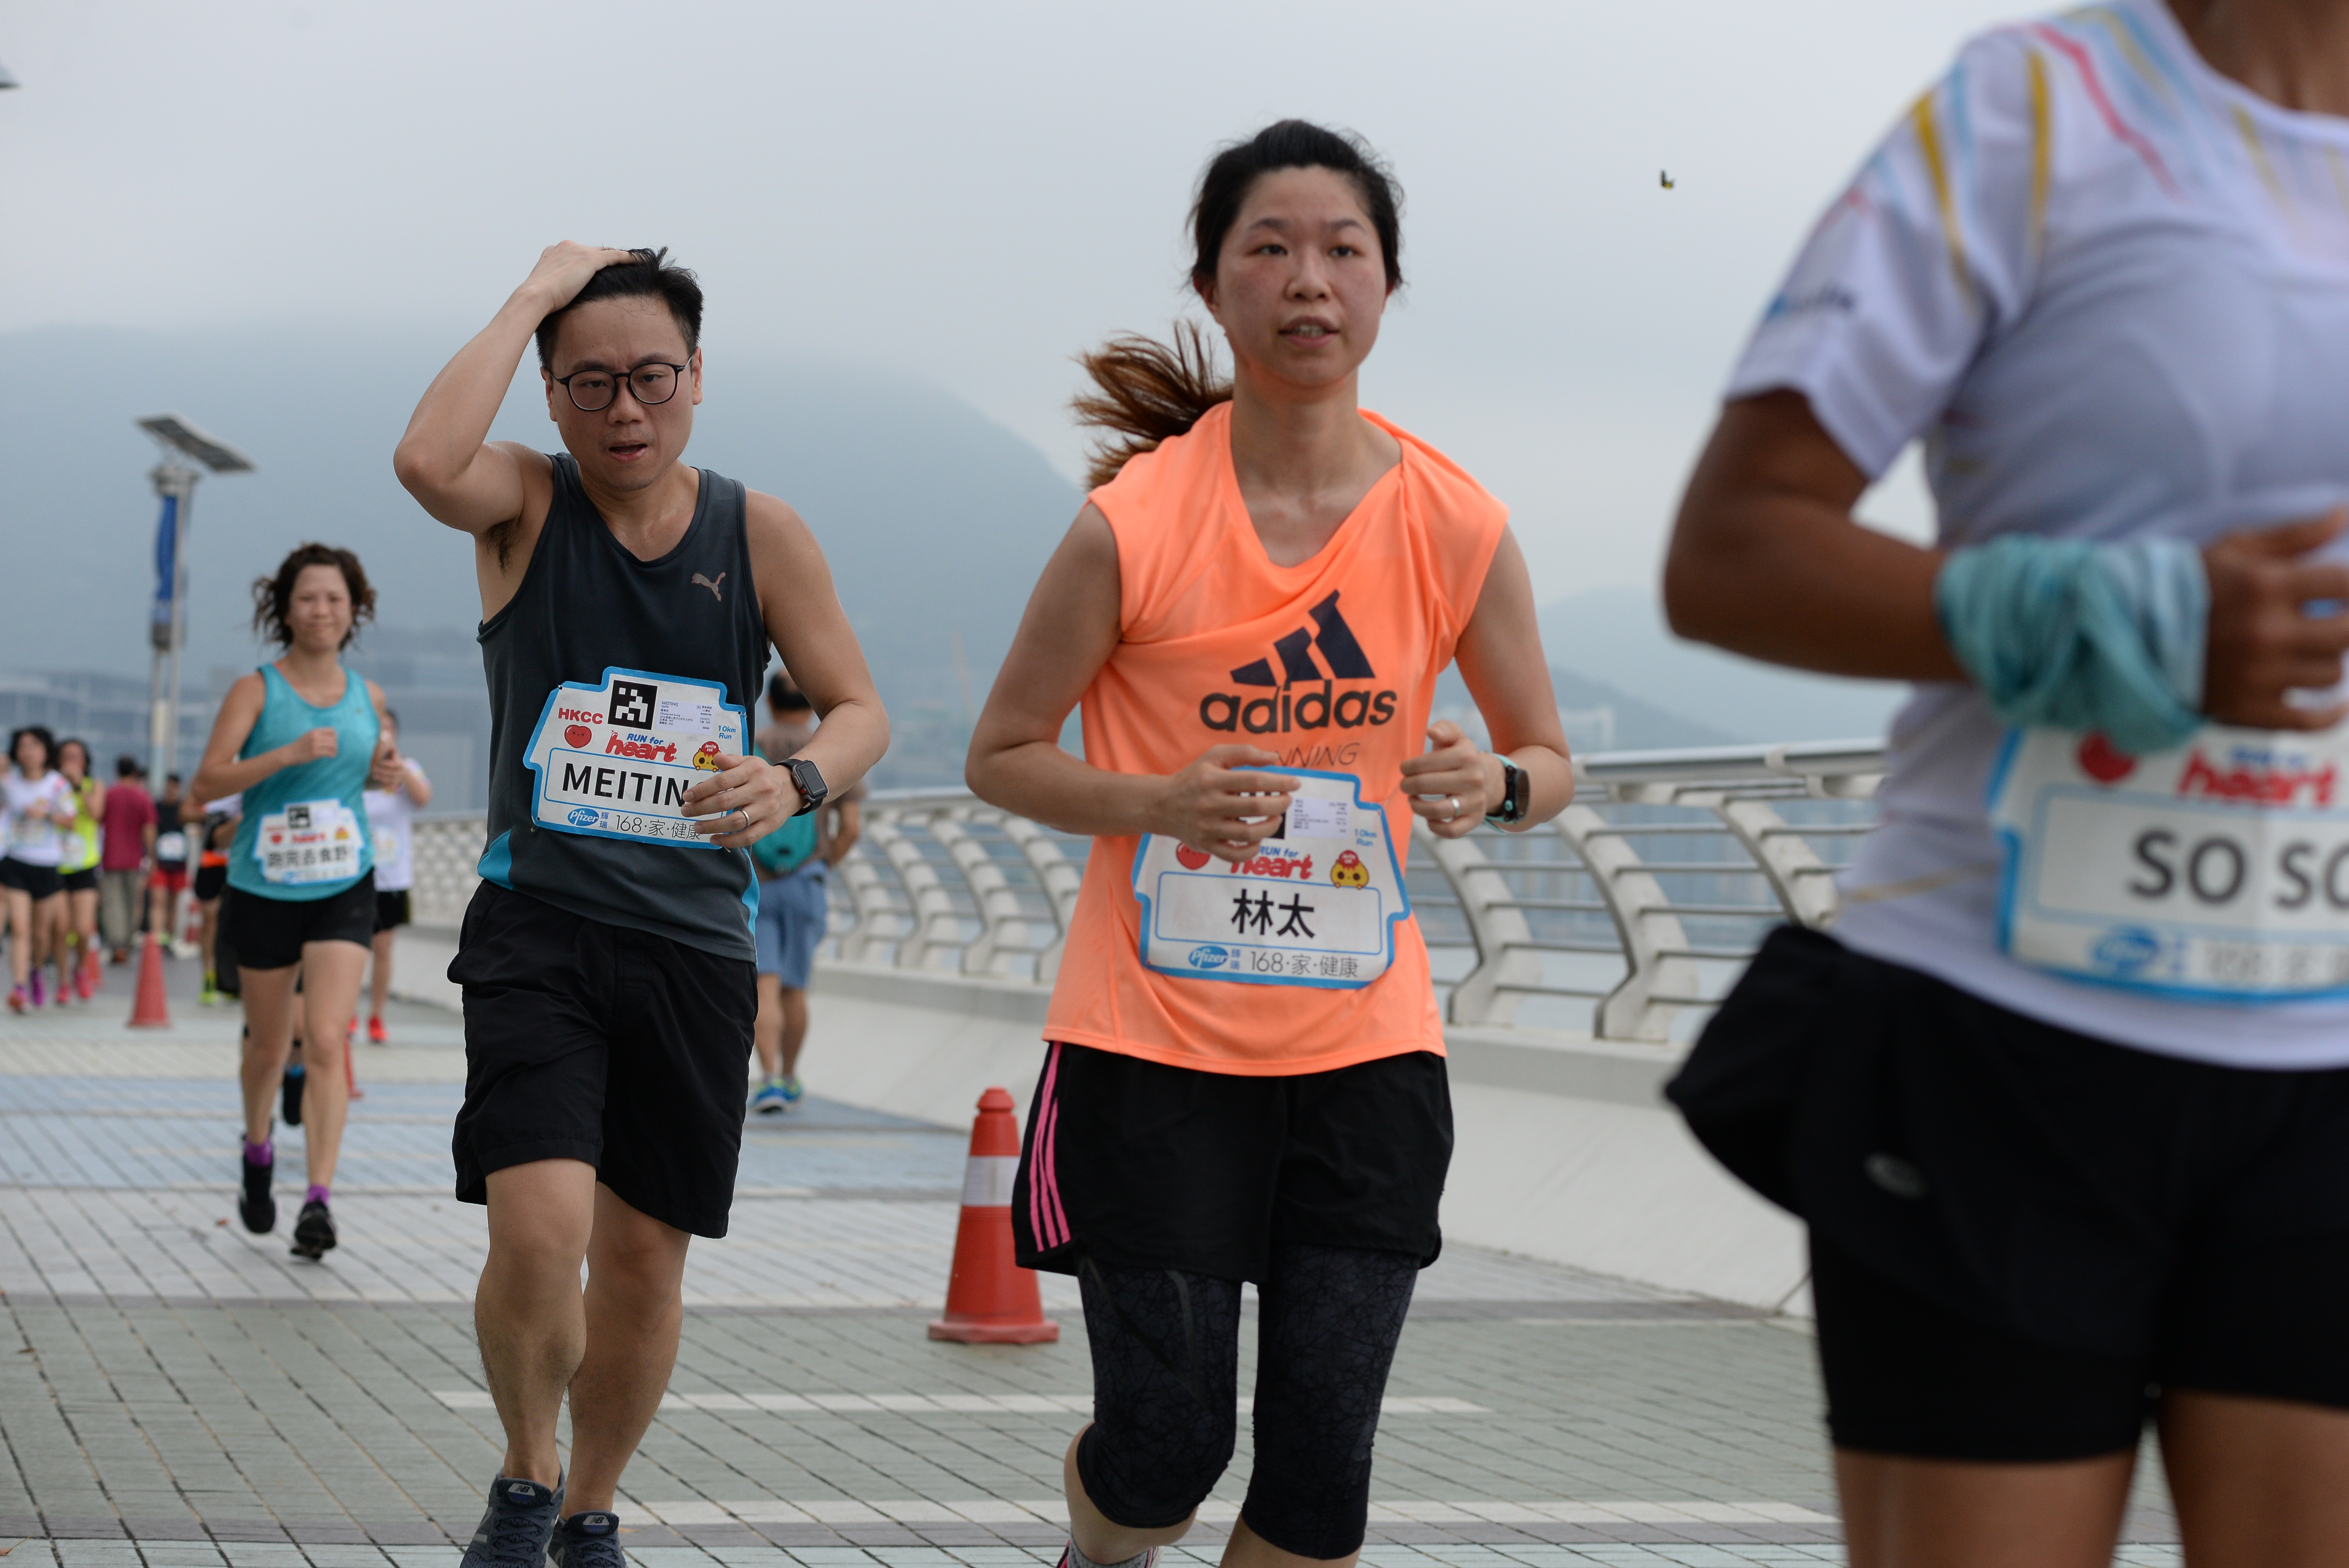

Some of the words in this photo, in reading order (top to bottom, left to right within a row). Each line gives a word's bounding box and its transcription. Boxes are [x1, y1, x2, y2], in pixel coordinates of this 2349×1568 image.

[558, 707, 603, 724] HKCC
[1200, 679, 1397, 734] adidas
[605, 732, 677, 763] heart
[627, 733, 648, 743] RUN
[650, 737, 664, 745] for
[1274, 742, 1360, 768] NNING
[562, 763, 703, 807] MEITIN
[569, 810, 599, 826] Pfizer
[599, 811, 609, 829] 輝瑞
[1260, 845, 1281, 855] RUN
[1284, 848, 1299, 857] for
[2127, 828, 2248, 906] SO
[1230, 889, 1316, 939] 林太
[1190, 946, 1228, 969] Pfizer
